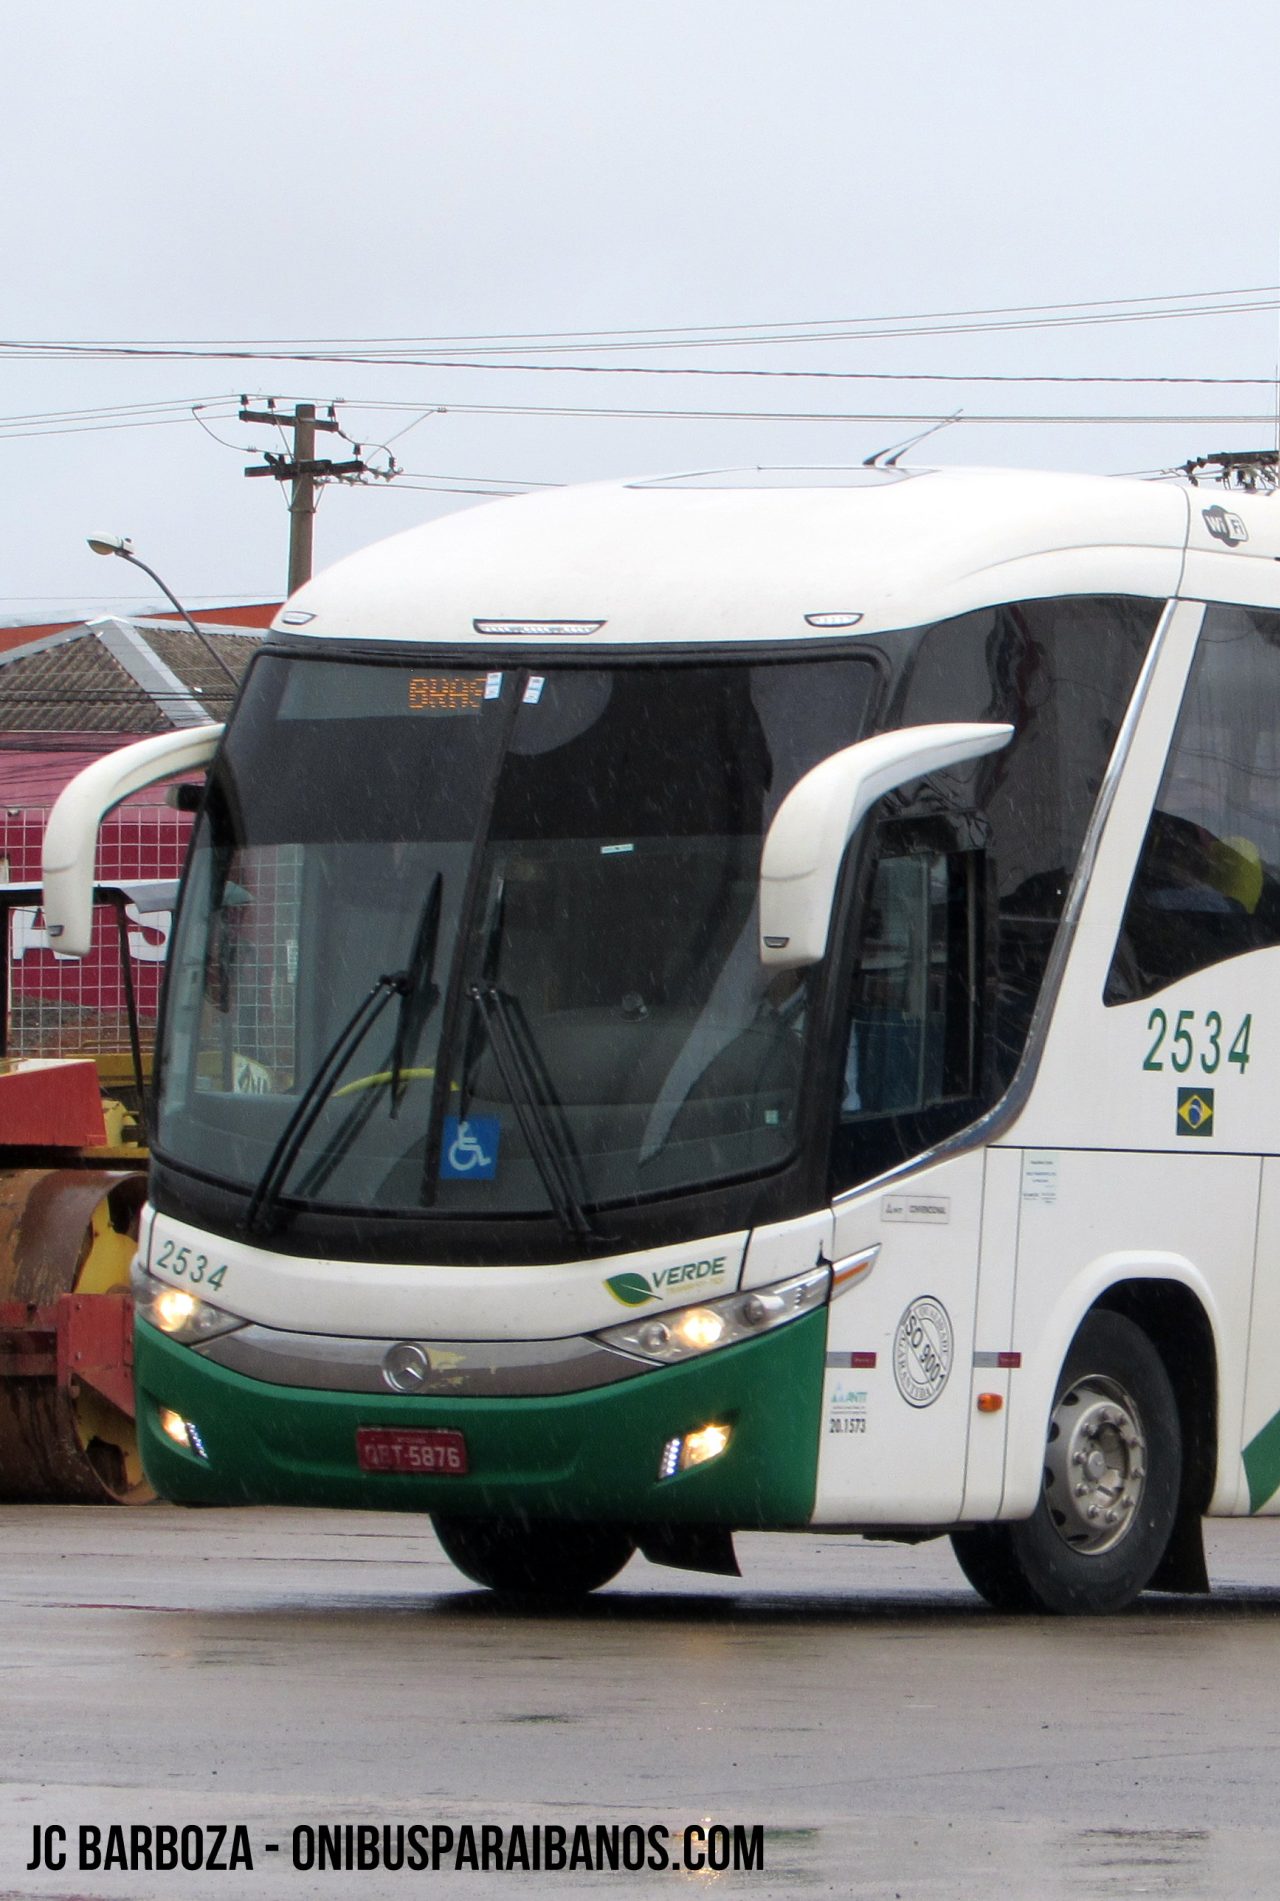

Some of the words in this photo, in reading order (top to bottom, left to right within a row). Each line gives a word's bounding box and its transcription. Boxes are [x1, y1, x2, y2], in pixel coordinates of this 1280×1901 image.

[1143, 1008, 1252, 1074] 2534
[156, 1240, 228, 1291] 2534
[652, 1256, 727, 1288] VERDE
